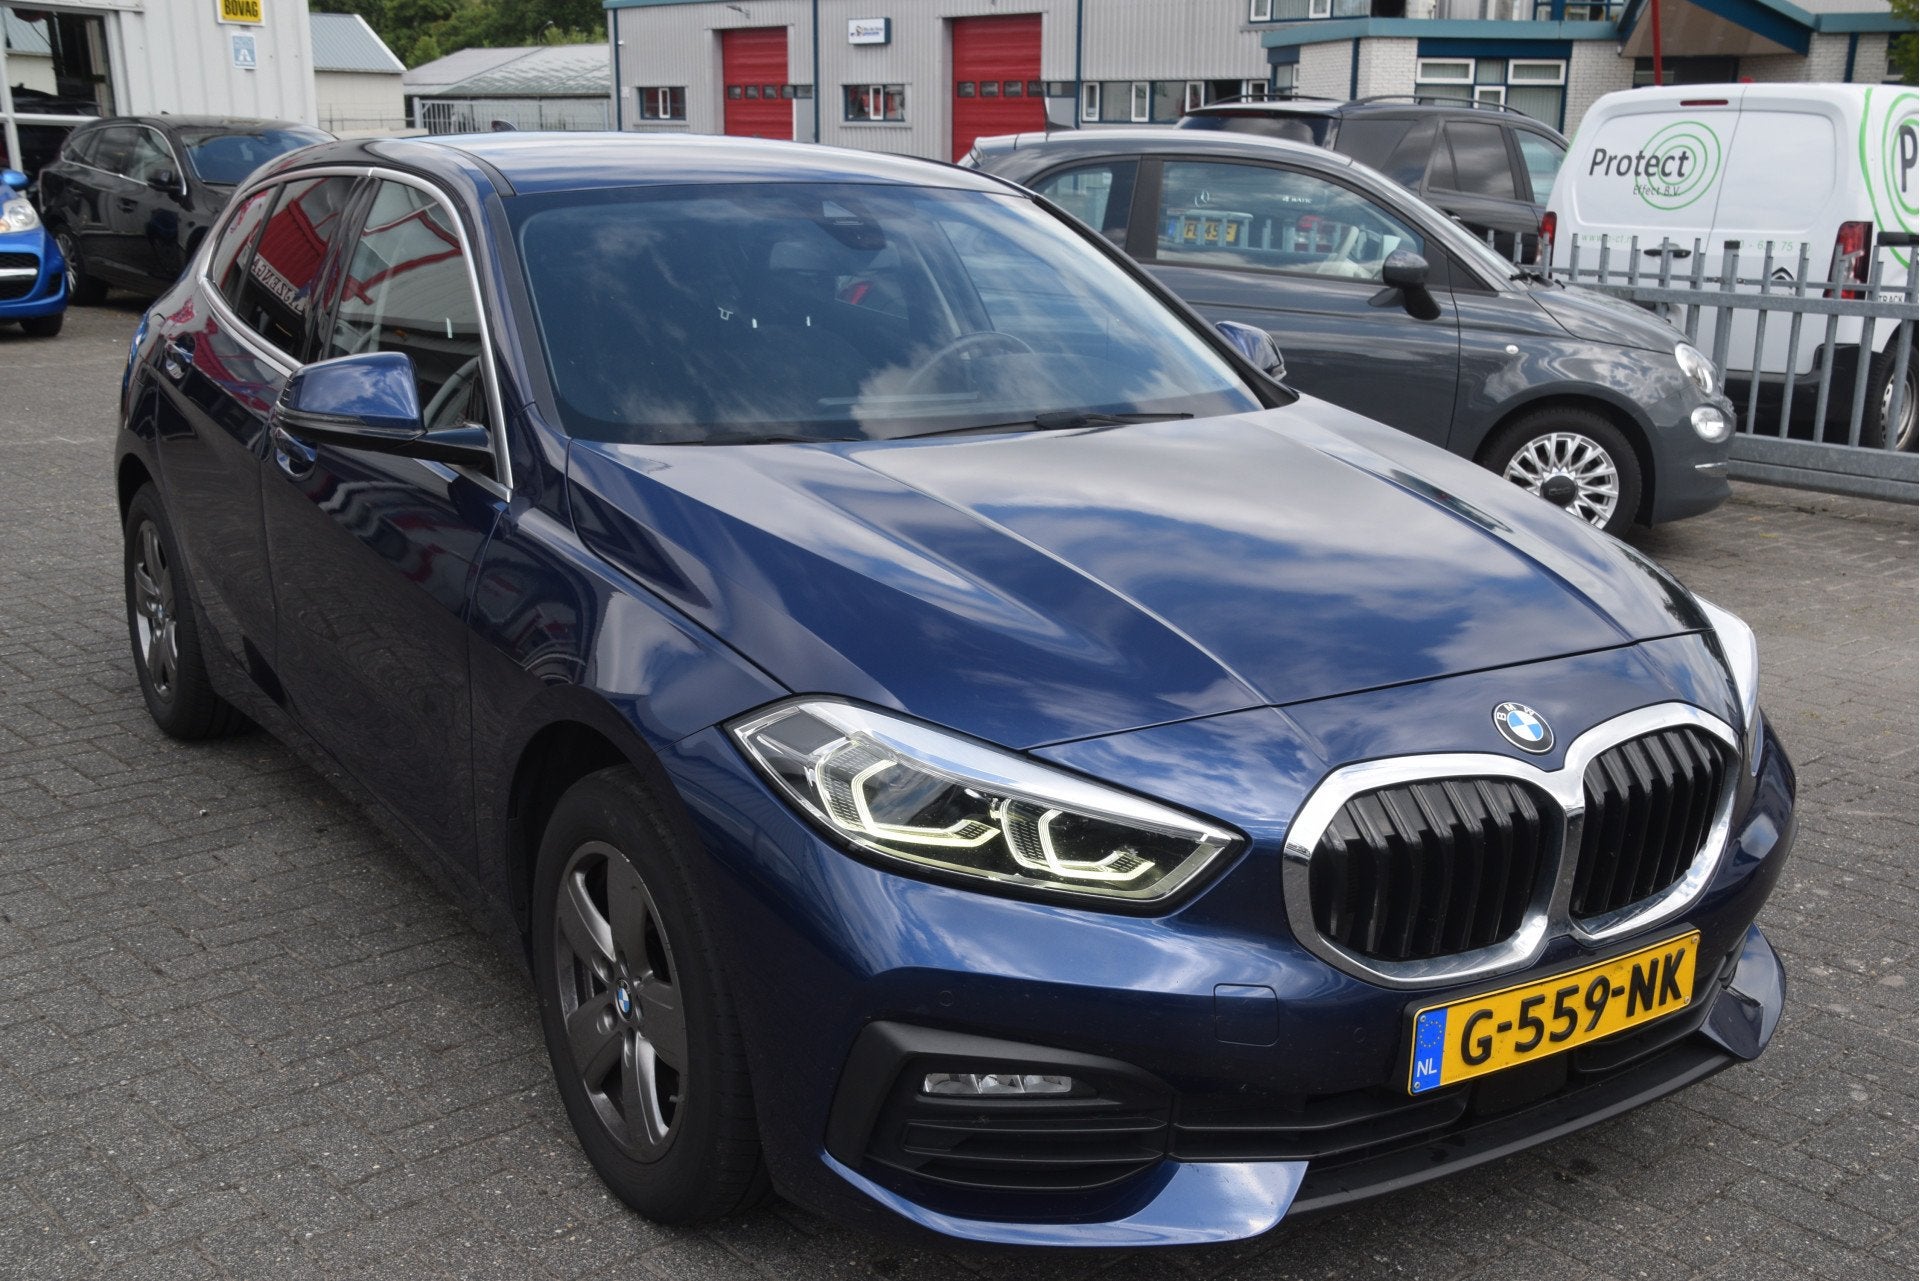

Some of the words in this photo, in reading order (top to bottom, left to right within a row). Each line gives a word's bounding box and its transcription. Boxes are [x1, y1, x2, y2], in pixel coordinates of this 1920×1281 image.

[224, 0, 259, 18] BOVAG
[1588, 148, 1690, 178] Protect
[1632, 184, 1660, 196] Effect
[1496, 703, 1536, 722] BMW
[1460, 947, 1686, 1067] G-559-NK
[1416, 1057, 1438, 1078] NL
